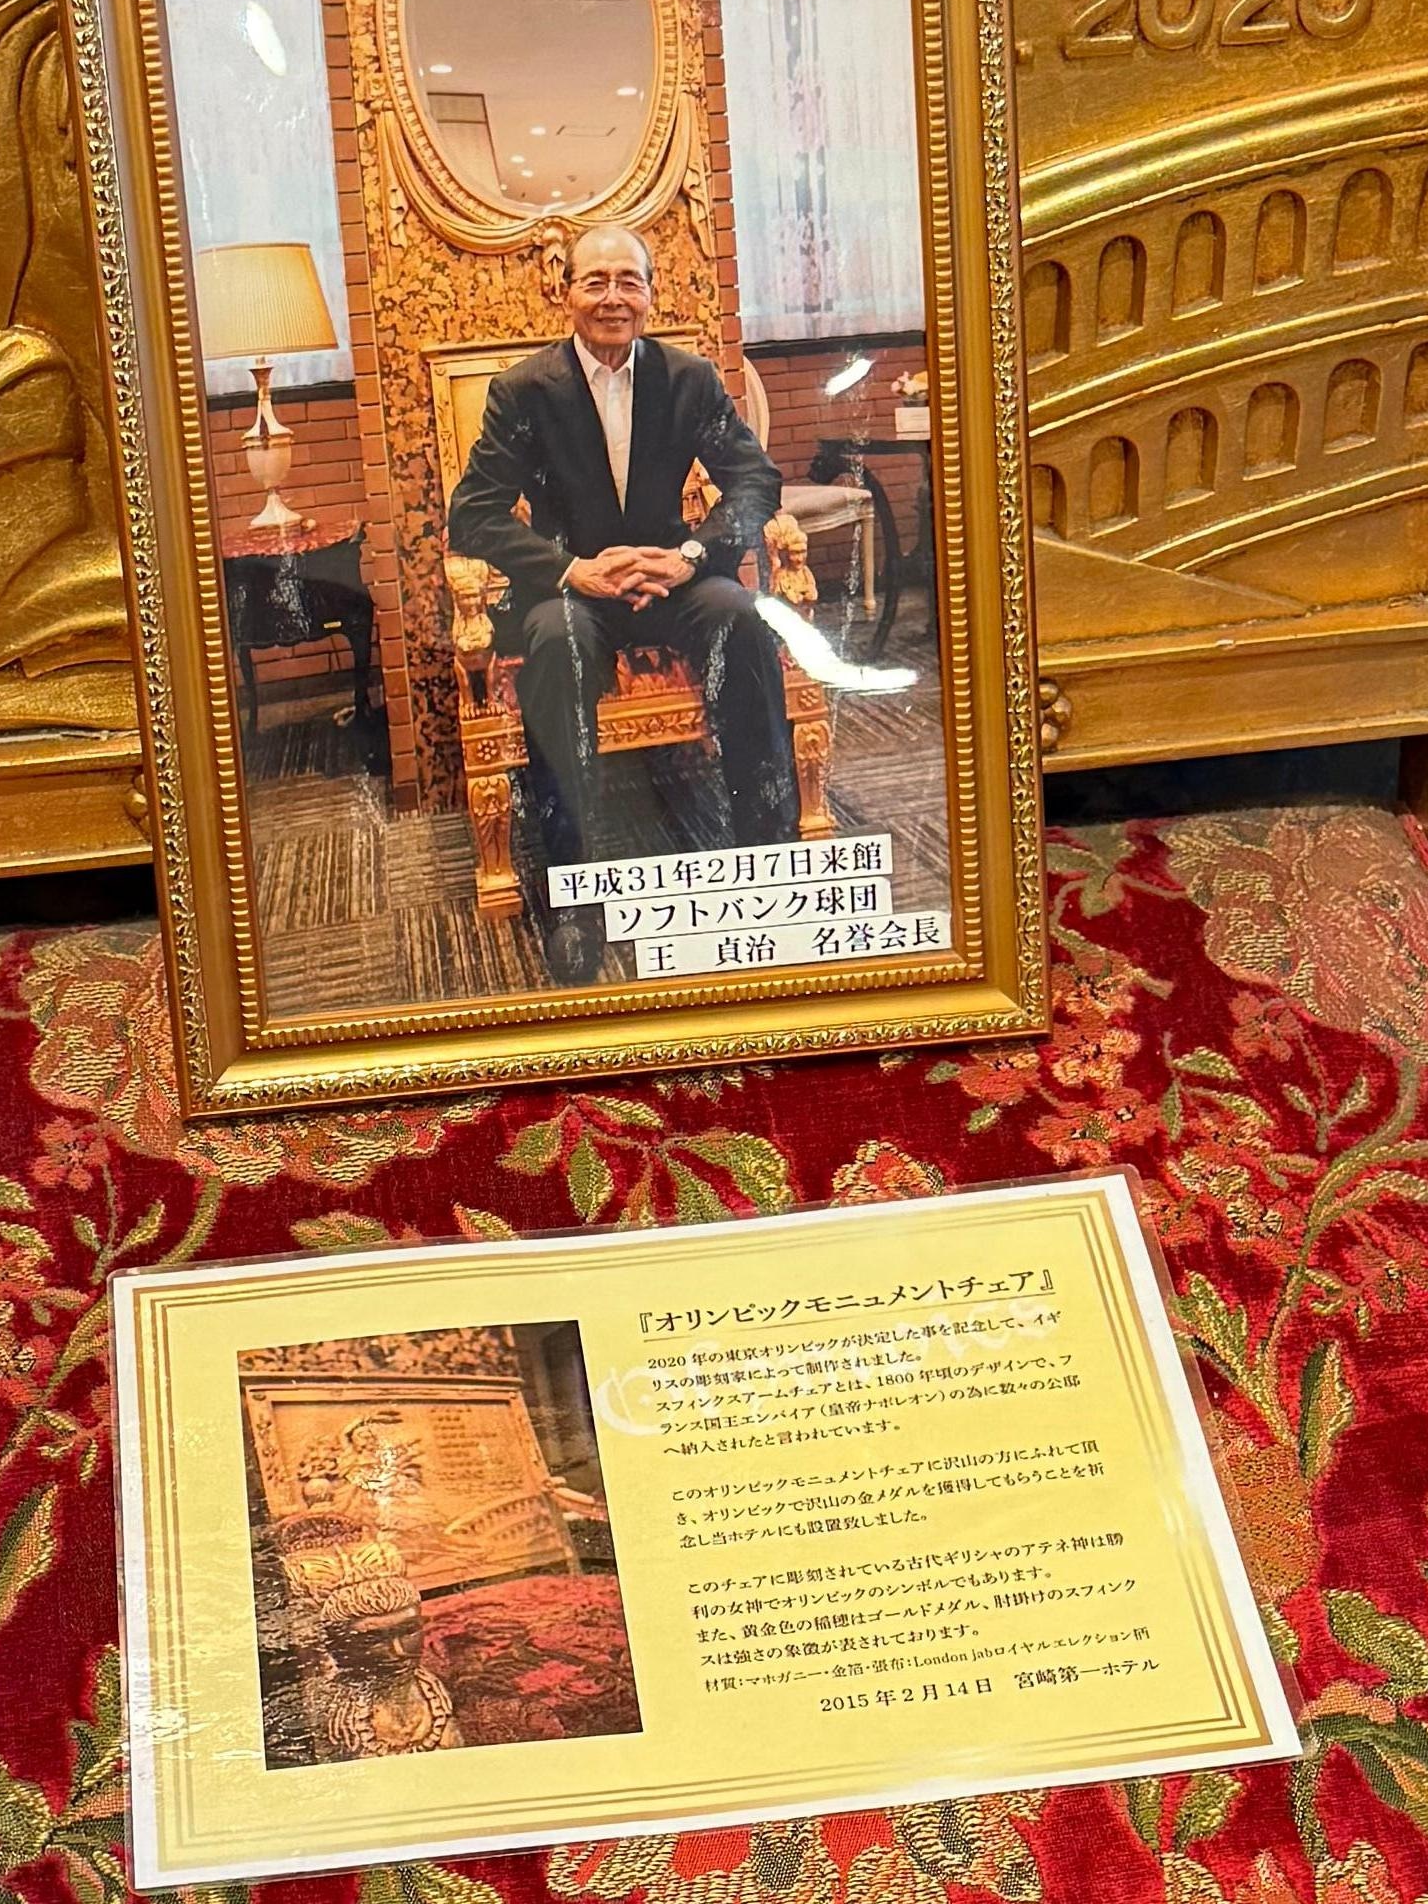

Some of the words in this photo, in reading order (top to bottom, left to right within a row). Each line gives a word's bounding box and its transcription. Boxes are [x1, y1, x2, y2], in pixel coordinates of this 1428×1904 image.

[559, 841, 882, 900] 平成31年2月7日来館
[618, 883, 877, 934] ソフトバンク球団
[715, 933, 776, 967] 貞治
[812, 916, 940, 956] 名誉会長
[638, 1268, 1055, 1334] 『オリンピックモニュメントチェア』
[1014, 1657, 1160, 1691] 宮崎第一ホテル
